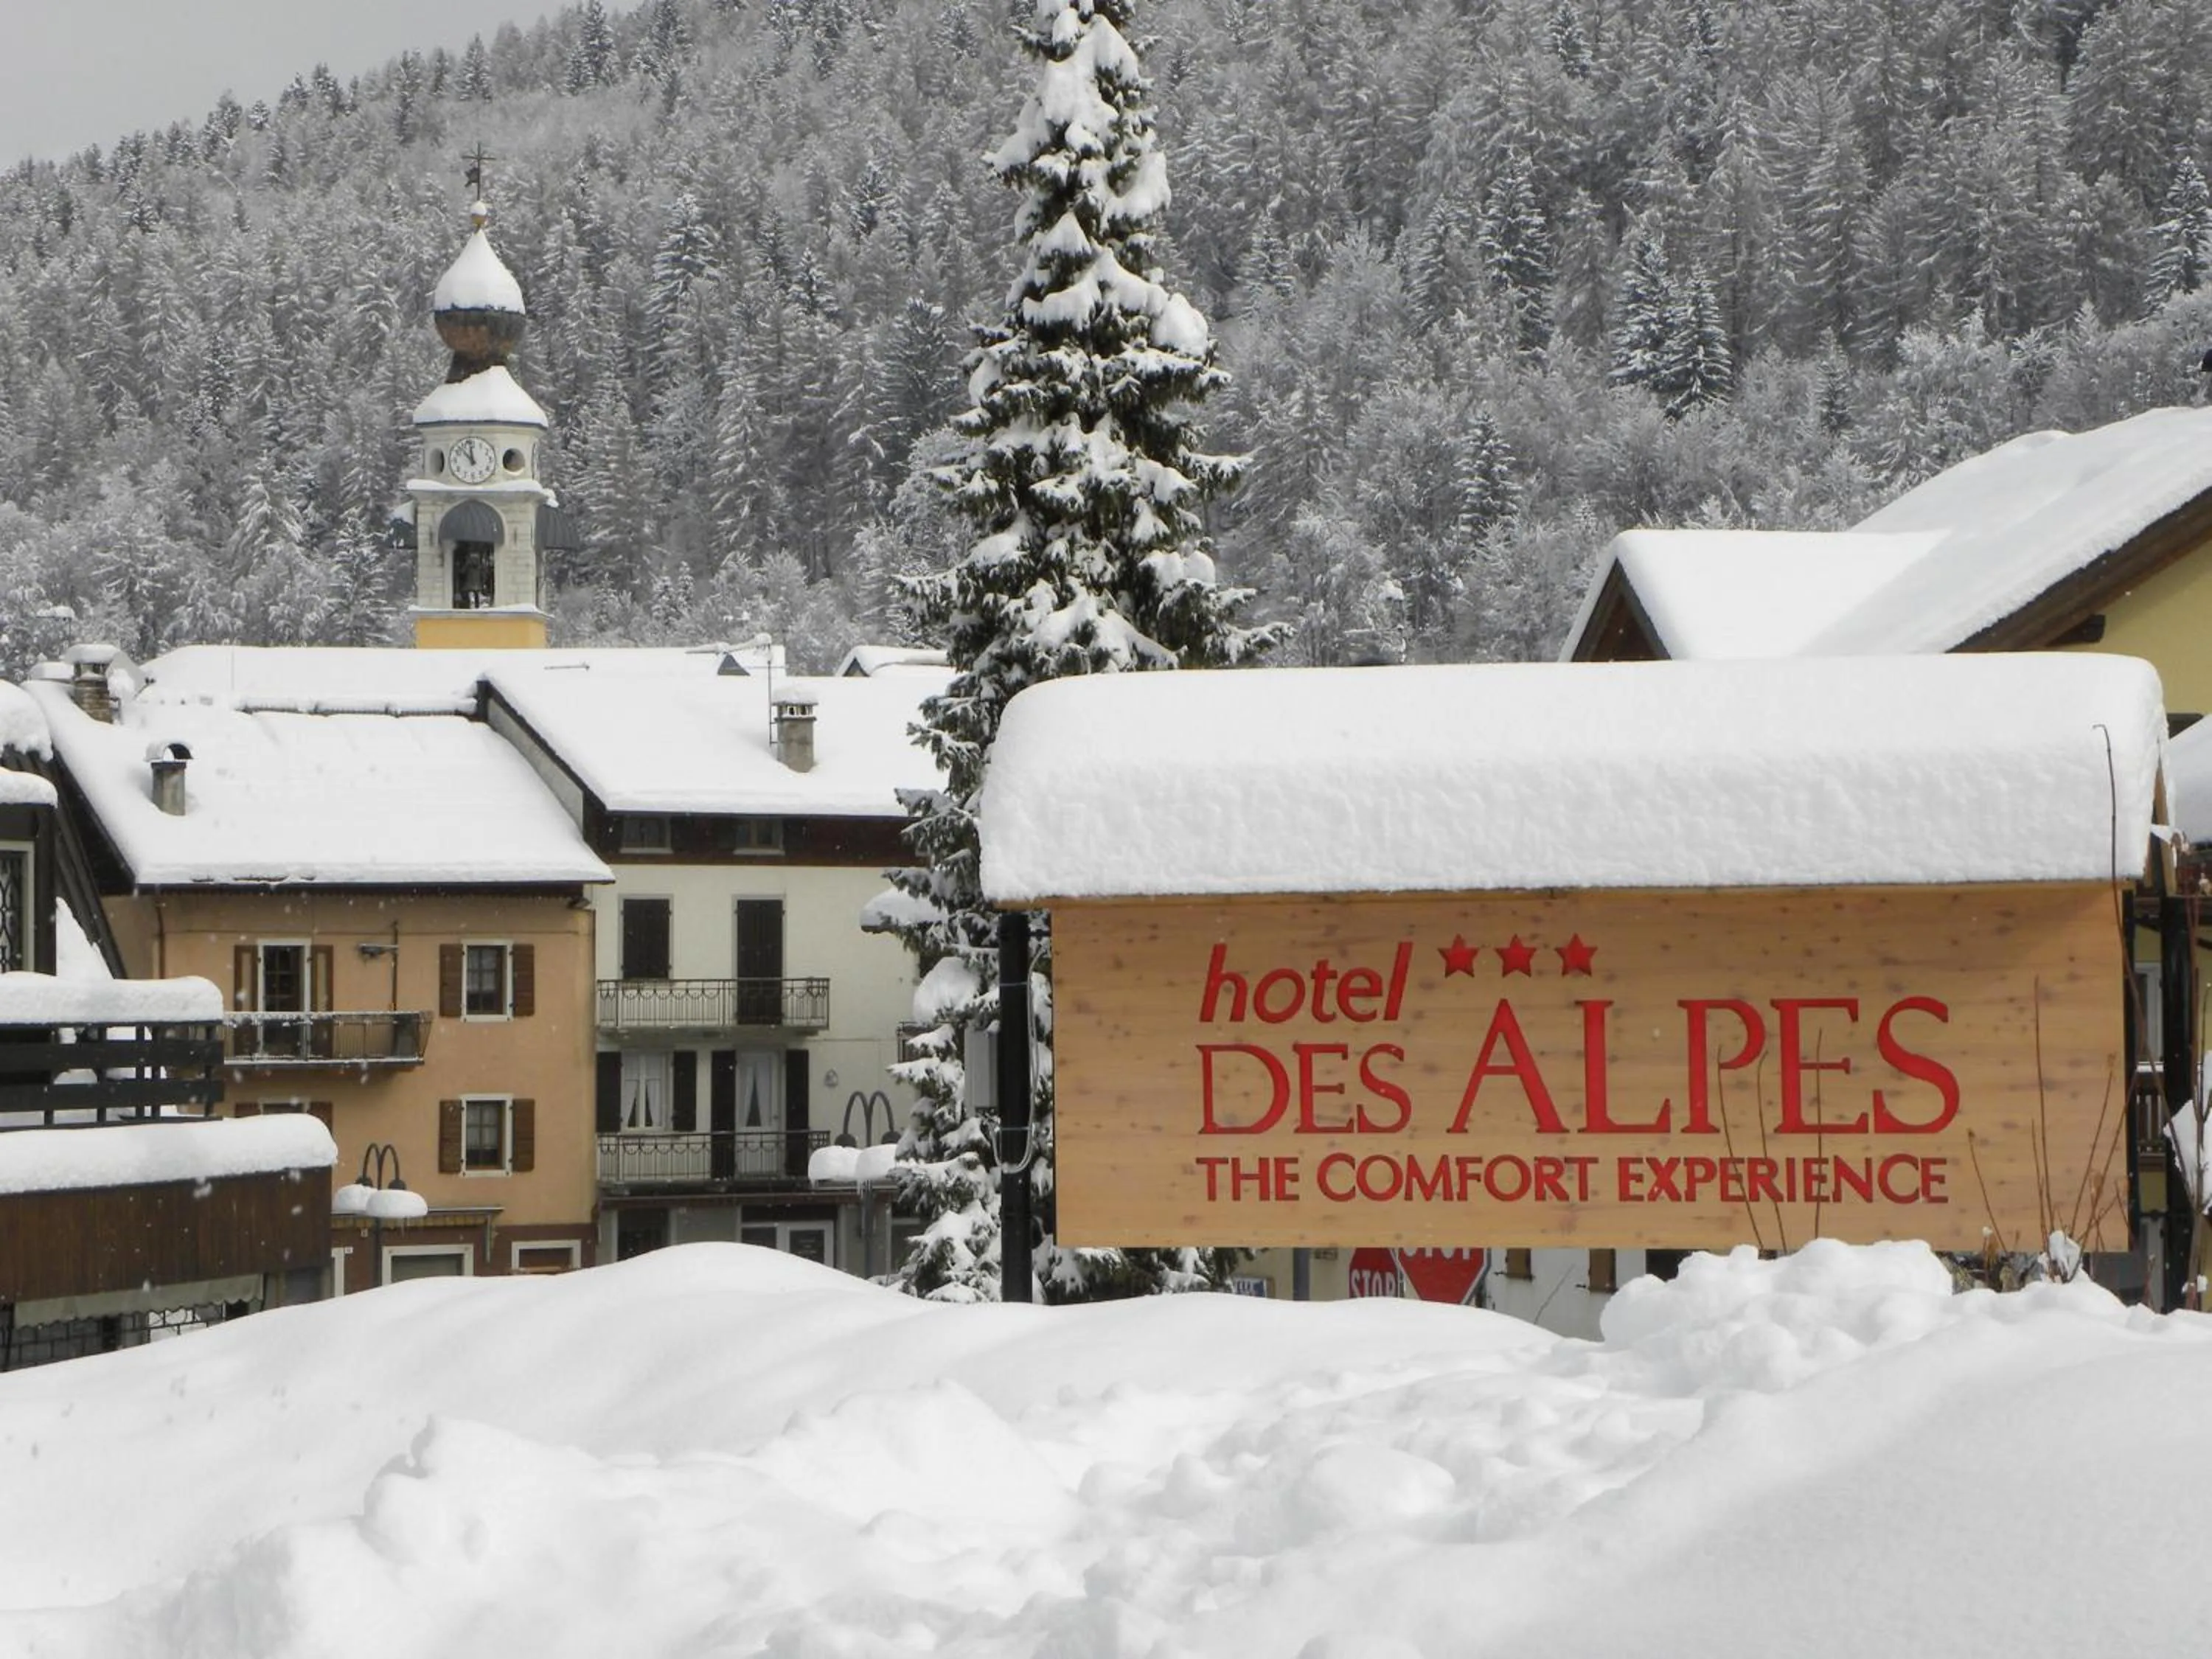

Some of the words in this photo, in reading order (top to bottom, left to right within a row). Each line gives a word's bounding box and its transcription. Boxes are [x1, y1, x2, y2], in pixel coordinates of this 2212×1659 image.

[1200, 942, 1413, 1023] hotel
[1195, 1041, 1412, 1134] DES
[1446, 996, 1961, 1134] ALPES
[1195, 1156, 1300, 1202] THE
[1316, 1152, 1599, 1203] COMFORT
[1618, 1153, 1949, 1203] EXPERIENCE
[1351, 1268, 1396, 1298] STOP
